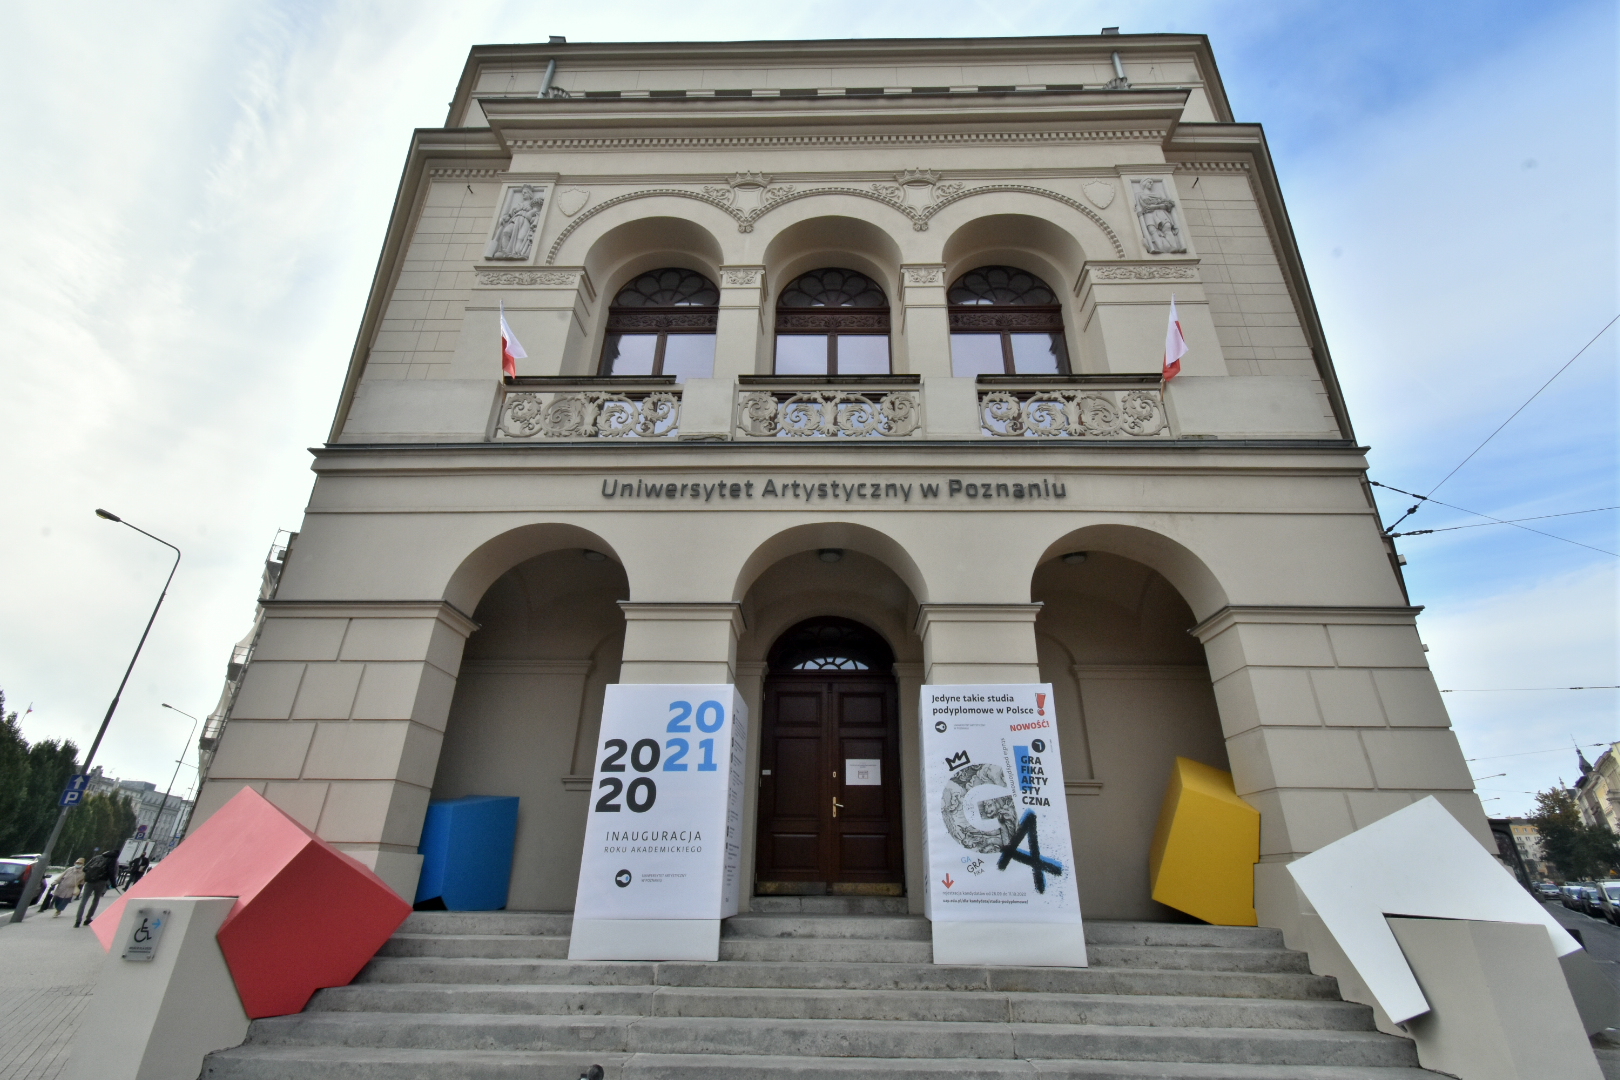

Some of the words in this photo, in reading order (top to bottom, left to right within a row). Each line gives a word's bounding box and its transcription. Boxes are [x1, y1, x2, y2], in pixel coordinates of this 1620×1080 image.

[601, 478, 753, 501] Uniwersytet
[761, 478, 912, 501] Artystyczny
[919, 483, 940, 498] w
[949, 478, 1067, 498] Poznaniu
[931, 694, 960, 704] Jedyne
[963, 694, 985, 702] takie
[987, 694, 1014, 702] studia
[666, 700, 725, 733] 20
[932, 706, 994, 716] podyplomowe
[1006, 706, 1034, 714] Polsce
[1009, 719, 1050, 732] NOWOŚĆ!
[600, 738, 660, 773] 20
[663, 737, 718, 772] 21
[1020, 755, 1042, 765] GRA
[1021, 765, 1044, 775] FIKA
[1004, 756, 1017, 798] podyplomowe
[1021, 775, 1048, 786] ARTY
[595, 777, 657, 813] 20
[1021, 785, 1041, 795] STY
[64, 791, 79, 804] P
[1021, 795, 1051, 807] CZNA
[605, 831, 702, 843] INAUGURACJA
[960, 856, 972, 864] GA
[966, 858, 985, 873] GRA
